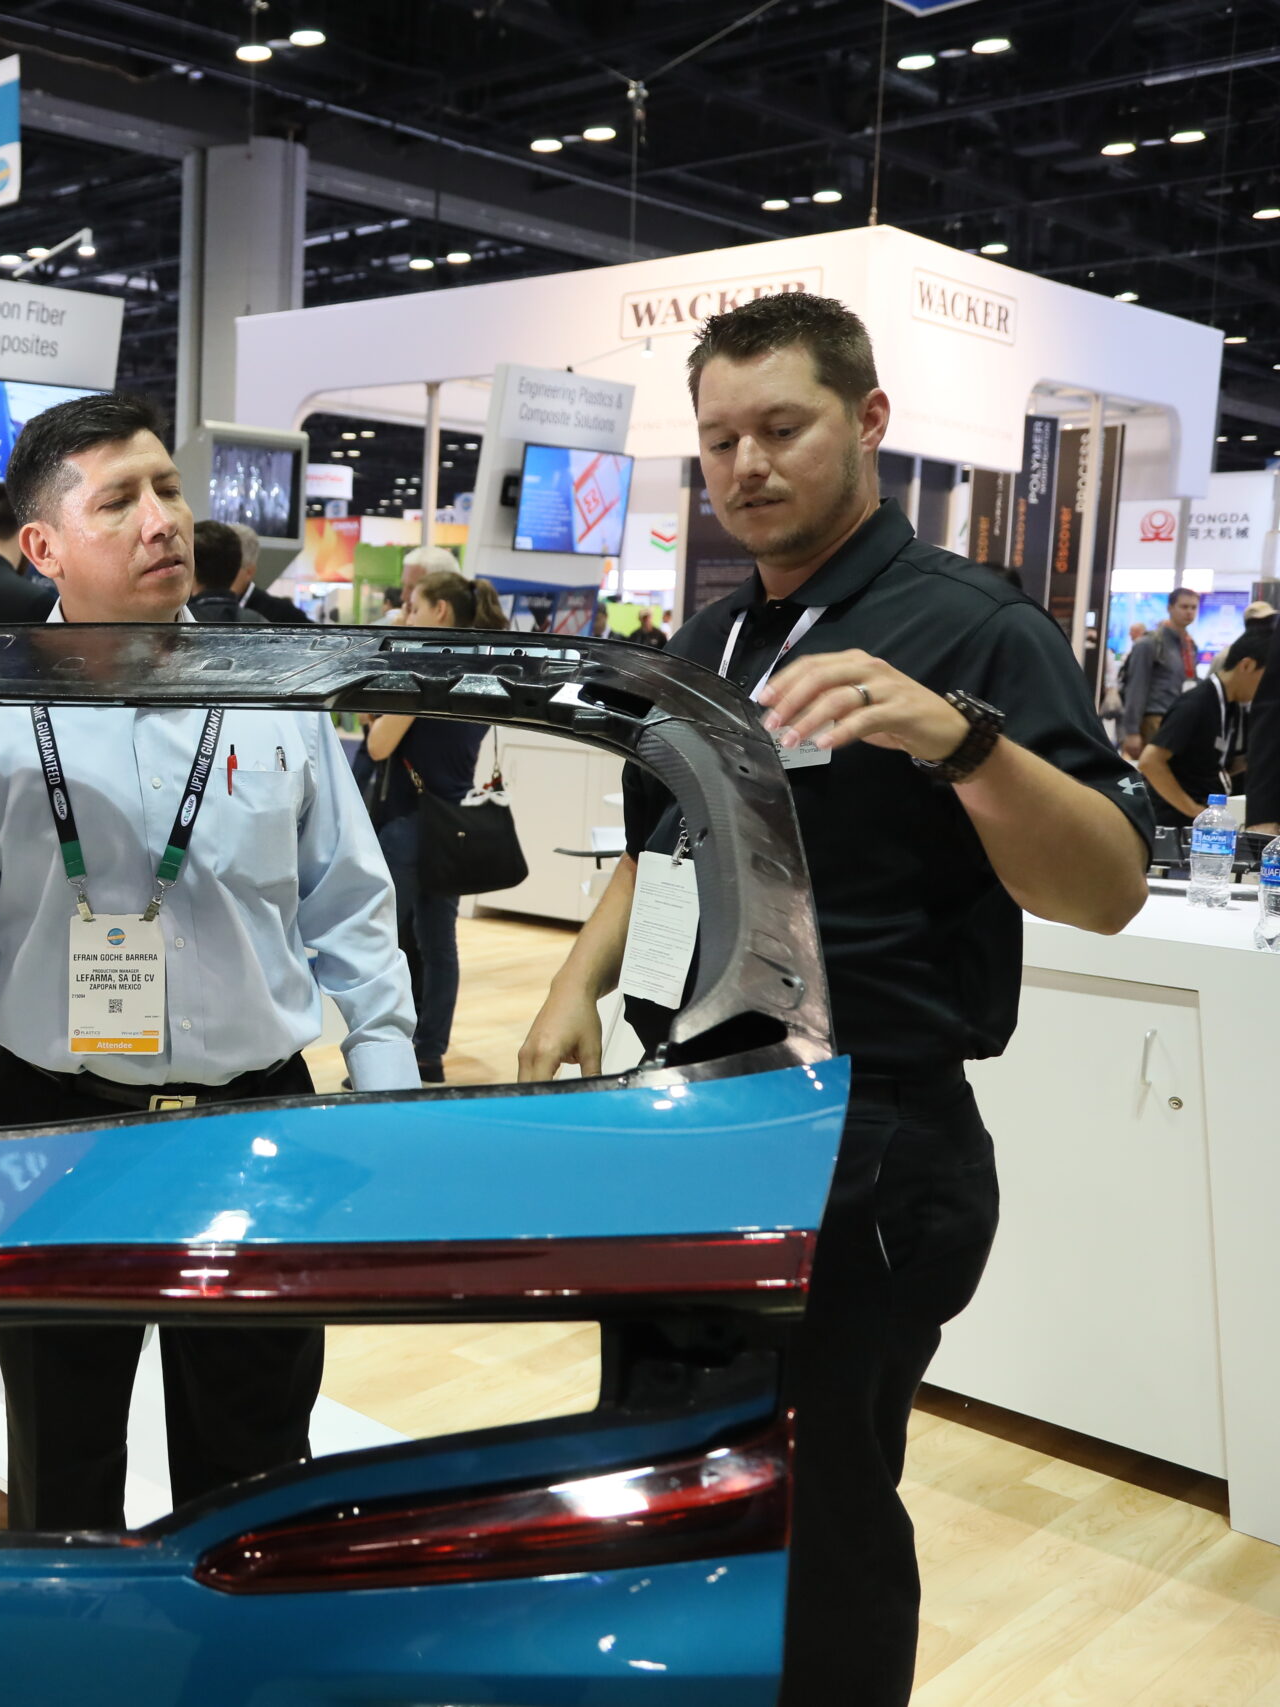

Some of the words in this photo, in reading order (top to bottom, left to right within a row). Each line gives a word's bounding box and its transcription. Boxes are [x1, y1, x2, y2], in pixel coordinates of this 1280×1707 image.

[26, 300, 67, 326] Fiber
[918, 279, 1012, 335] WACKER
[518, 376, 576, 403] Engineering
[579, 386, 613, 408] Plastics
[519, 402, 570, 427] Composite
[574, 411, 616, 433] Solutions
[1028, 420, 1045, 504] POLYMER
[1055, 506, 1072, 573] discover
[36, 721, 61, 785] GUARANTEED
[189, 754, 211, 792] UPTIME
[200, 708, 223, 757] GUARANT
[73, 953, 98, 962] EFRAIN
[100, 953, 123, 962] GOCHE
[125, 953, 158, 961] BARRERA
[76, 973, 116, 983] LEFARMA,
[118, 973, 129, 982] SA
[131, 973, 142, 982] DE
[144, 973, 155, 982] CV
[89, 983, 117, 991] ZAPOPAN
[119, 983, 142, 991] MEXICO
[96, 1041, 133, 1050] Attendee
